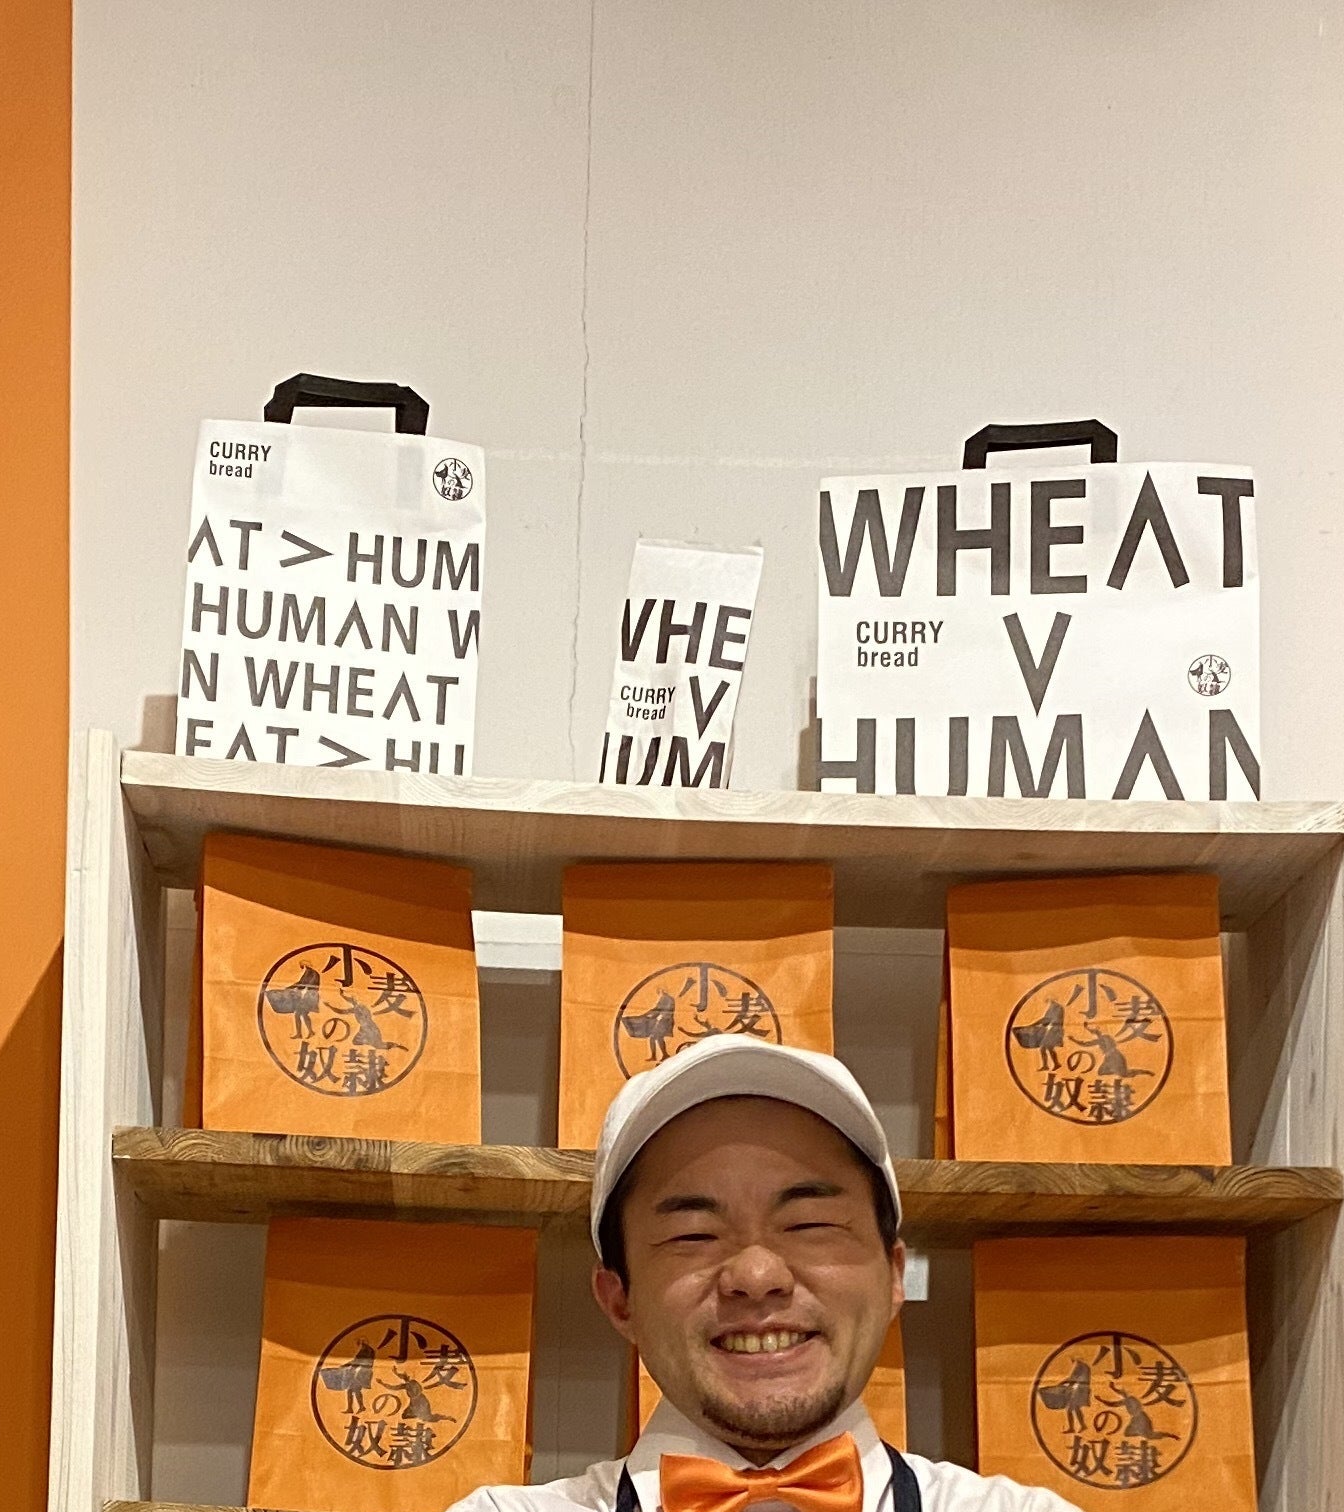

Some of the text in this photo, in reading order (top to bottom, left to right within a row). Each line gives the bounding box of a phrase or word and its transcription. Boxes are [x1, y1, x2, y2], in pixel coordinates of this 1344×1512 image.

[210, 441, 272, 462] CURRY
[209, 460, 253, 479] bread
[819, 470, 1254, 597] WHEAT
[347, 532, 479, 591] HUM
[192, 582, 418, 655] HUMAN
[856, 620, 944, 644] CURRY
[857, 647, 918, 668] bread
[181, 648, 459, 725] N WHEAT
[620, 685, 676, 704] CURRY
[626, 703, 666, 720] bread
[599, 732, 725, 789] UM
[322, 946, 421, 1018] 小麦
[1066, 972, 1163, 1043] 小麦
[322, 1018, 350, 1041] の
[1067, 1051, 1095, 1073] の
[377, 1319, 468, 1390] 小麦
[1093, 1336, 1186, 1407] 小麦
[372, 1394, 401, 1416] の
[1093, 1411, 1122, 1435] の
